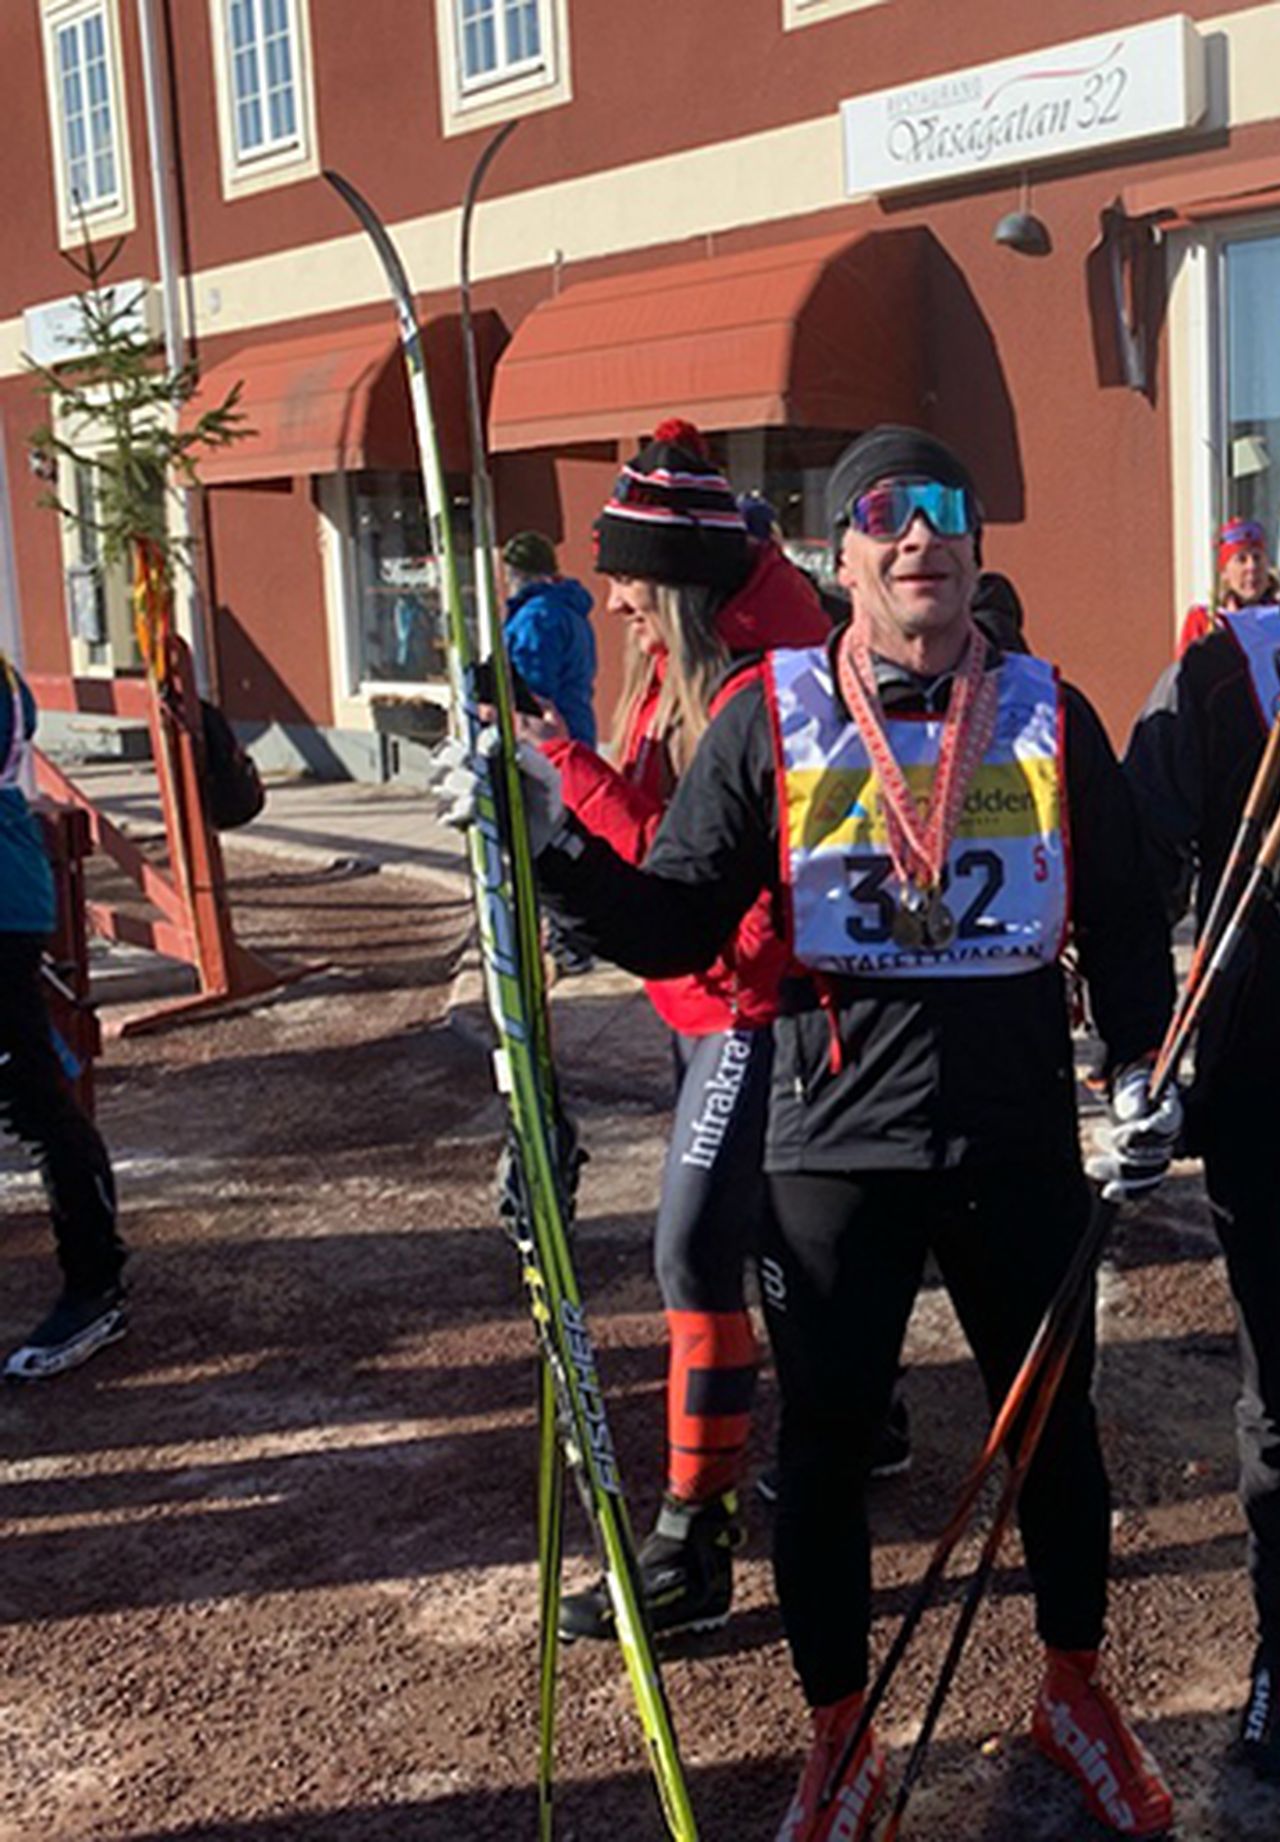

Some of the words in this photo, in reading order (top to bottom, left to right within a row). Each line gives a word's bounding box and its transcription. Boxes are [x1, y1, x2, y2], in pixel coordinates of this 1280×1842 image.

[887, 98, 1071, 163] Vasagatan
[1076, 66, 1127, 131] 32
[843, 849, 1007, 945] 32
[560, 1300, 621, 1496] FISCHER
